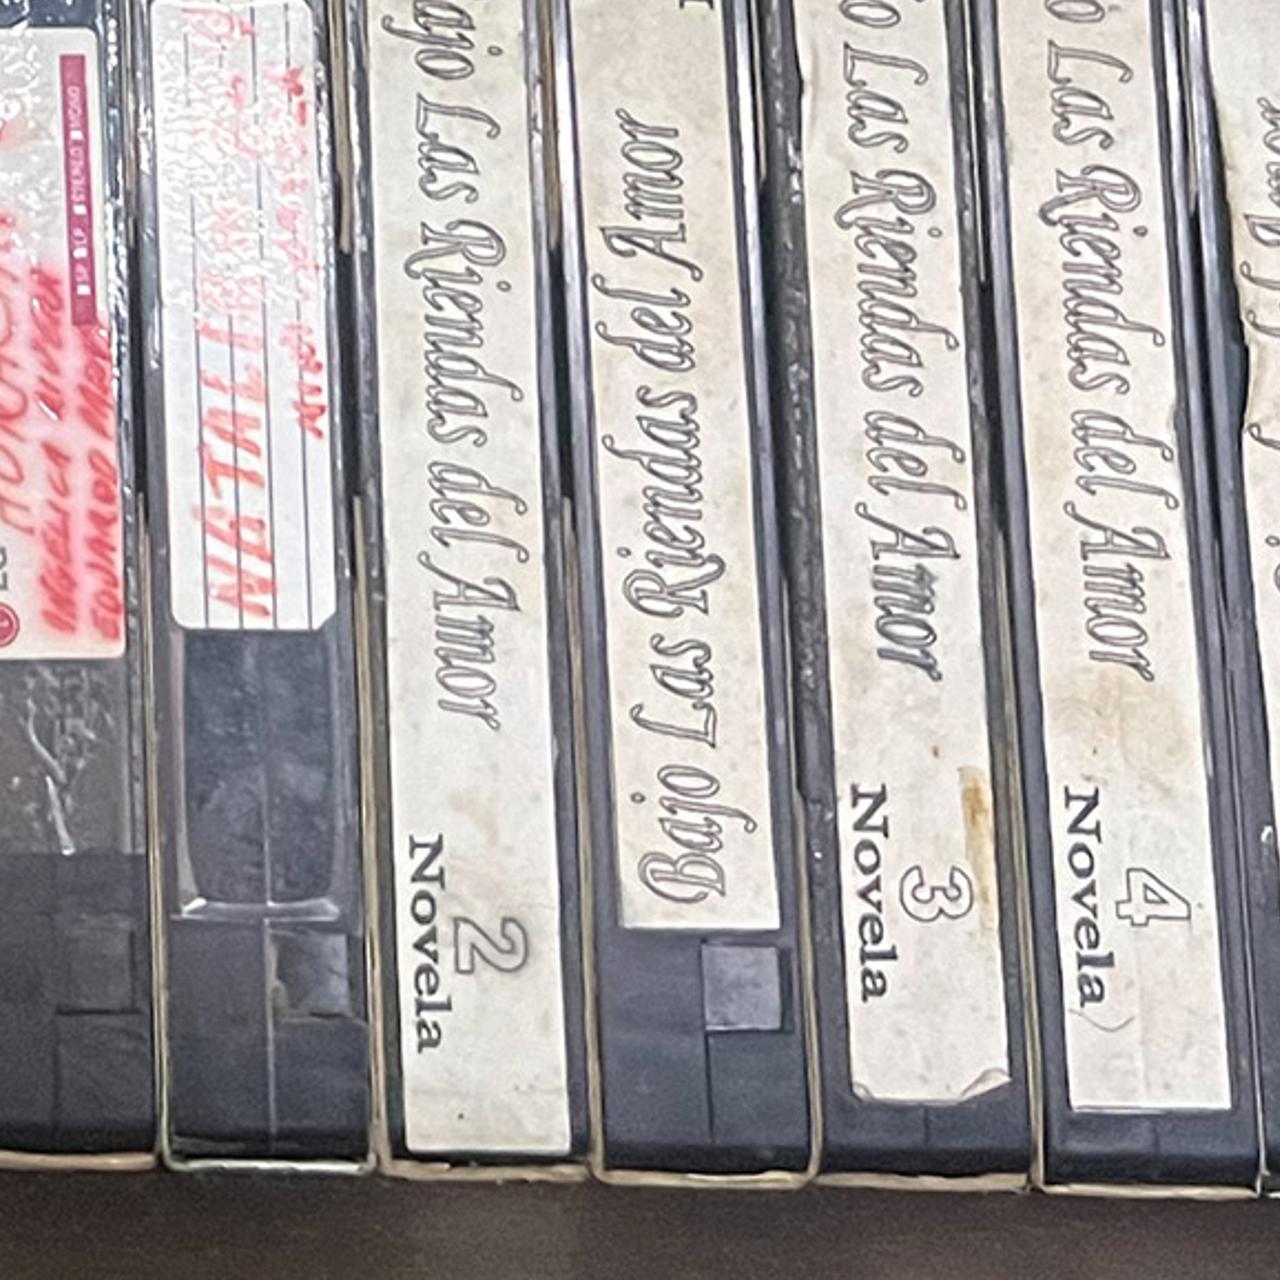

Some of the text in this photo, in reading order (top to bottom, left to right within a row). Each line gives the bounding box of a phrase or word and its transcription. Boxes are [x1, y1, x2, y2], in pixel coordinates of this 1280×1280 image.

[415, 94, 502, 204] Las
[842, 40, 930, 155] Las
[1047, 39, 1135, 150] Las
[403, 219, 525, 448] Riendas
[834, 167, 960, 399] Riendas
[1038, 163, 1166, 399] Riendas
[425, 460, 530, 564] del
[590, 106, 758, 905] Bajo Las Riendas del Amor
[863, 409, 968, 513] del
[1071, 407, 1180, 512] del
[417, 551, 523, 731] Amor
[855, 501, 961, 683] Amor
[1063, 500, 1172, 683] Amor
[408, 834, 453, 1055] Novela
[452, 916, 528, 977] 2
[850, 782, 899, 1003] Novela
[899, 864, 975, 924] 3
[1064, 785, 1115, 1008] Novela
[1115, 866, 1192, 928] 4
